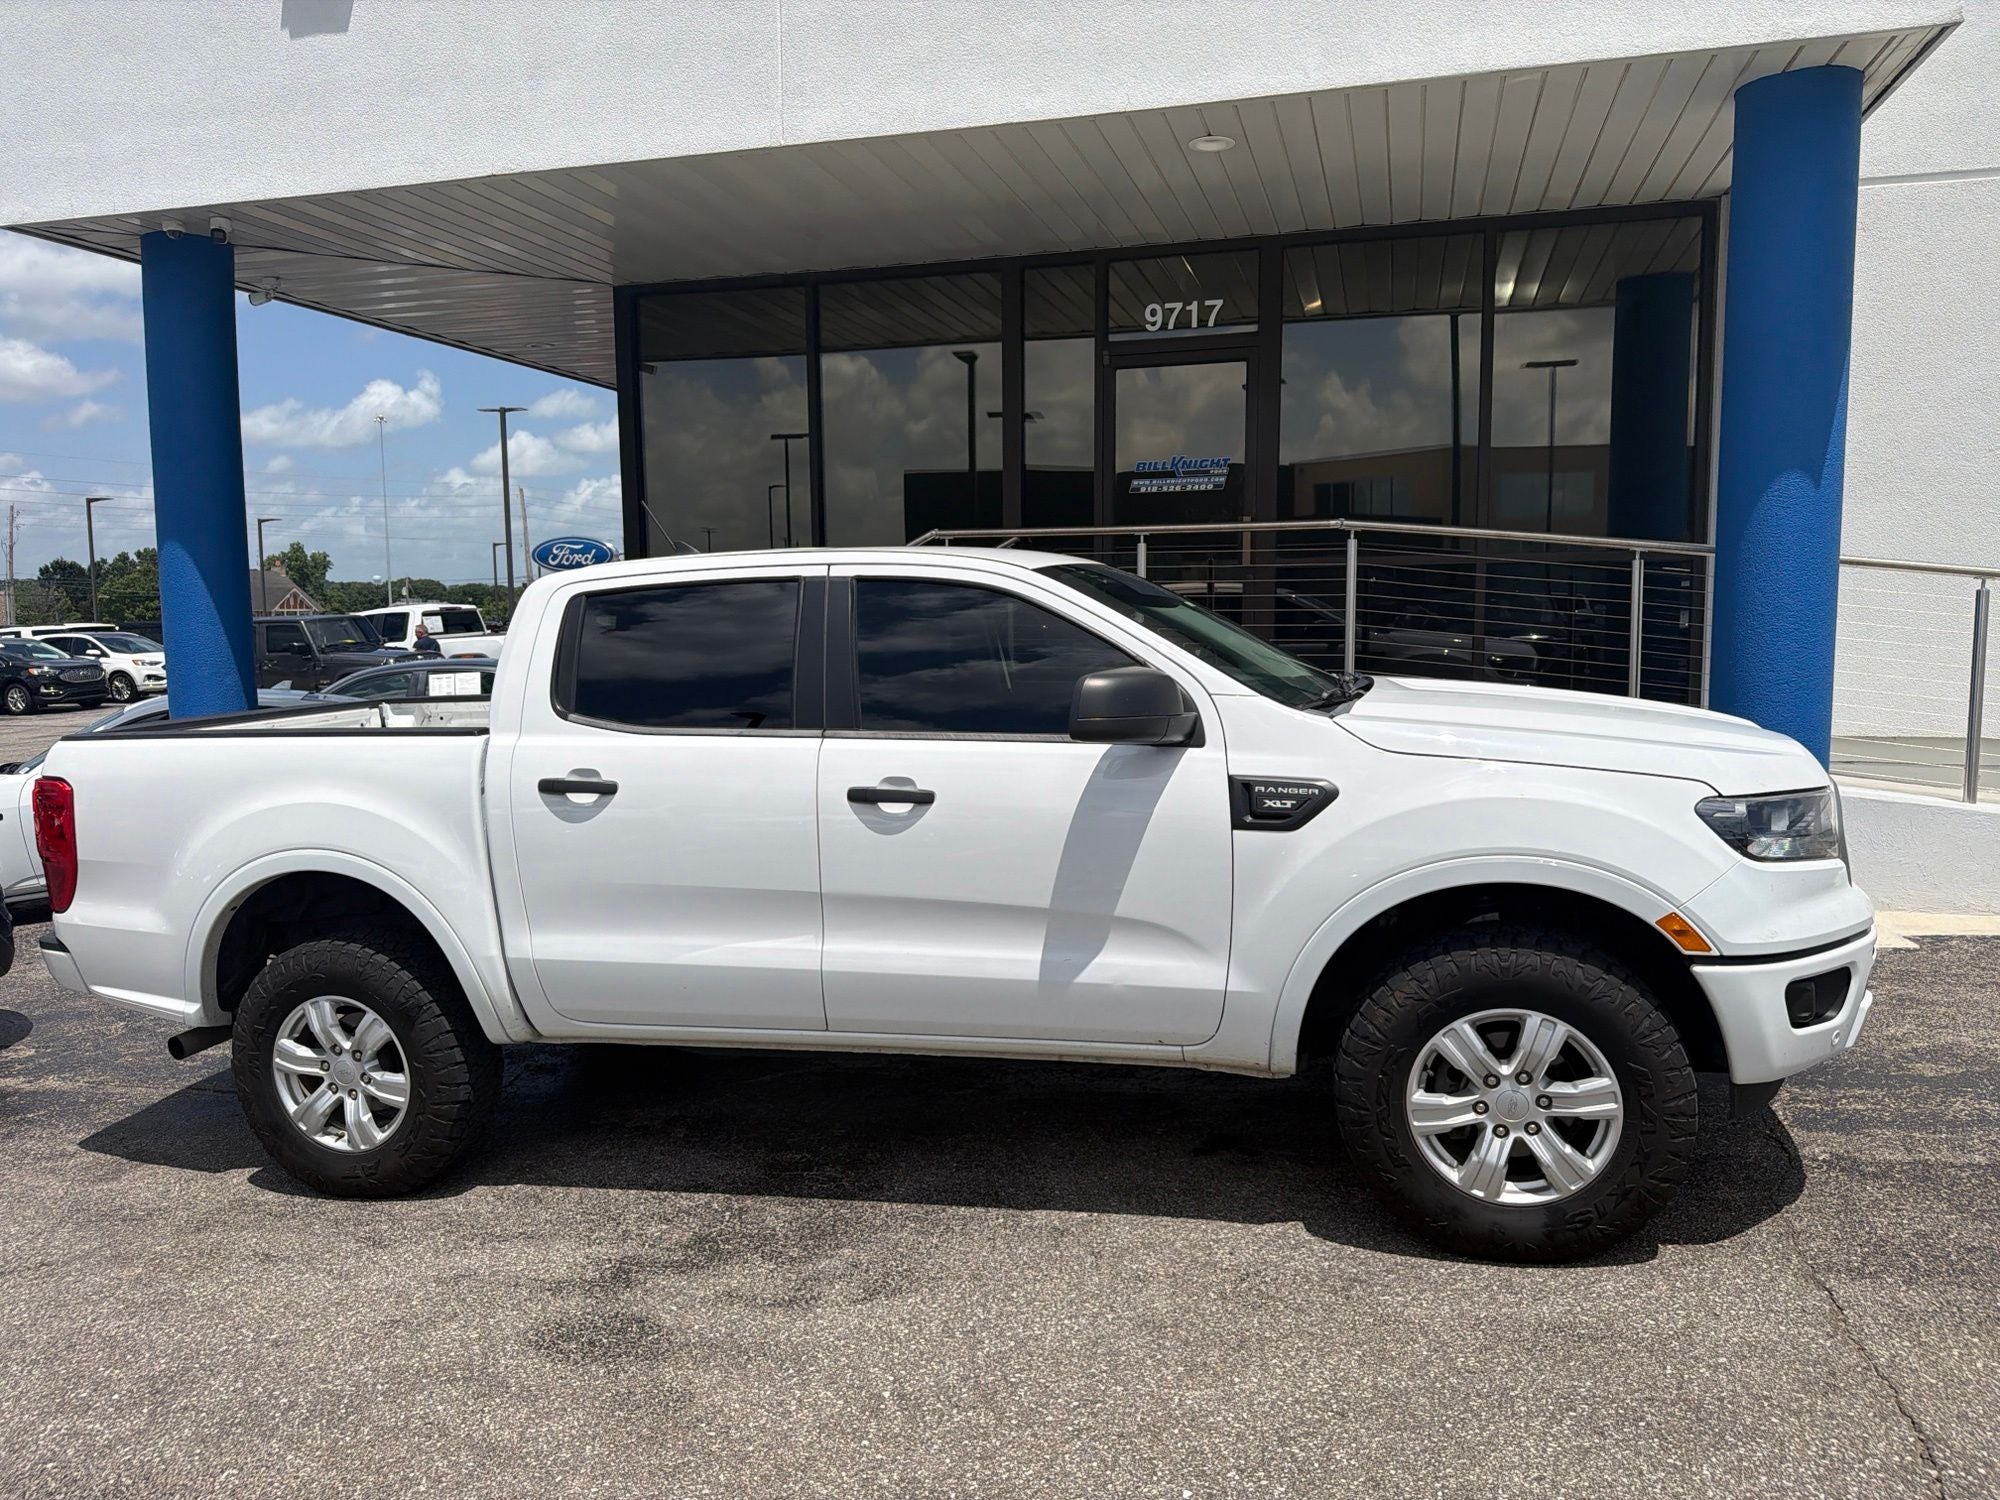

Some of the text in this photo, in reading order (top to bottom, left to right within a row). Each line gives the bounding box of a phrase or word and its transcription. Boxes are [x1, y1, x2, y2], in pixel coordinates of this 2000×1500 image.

[1144, 299, 1224, 332] 9717
[548, 543, 596, 565] Ford
[1255, 786, 1319, 795] RANGER
[1263, 799, 1297, 808] XLT
